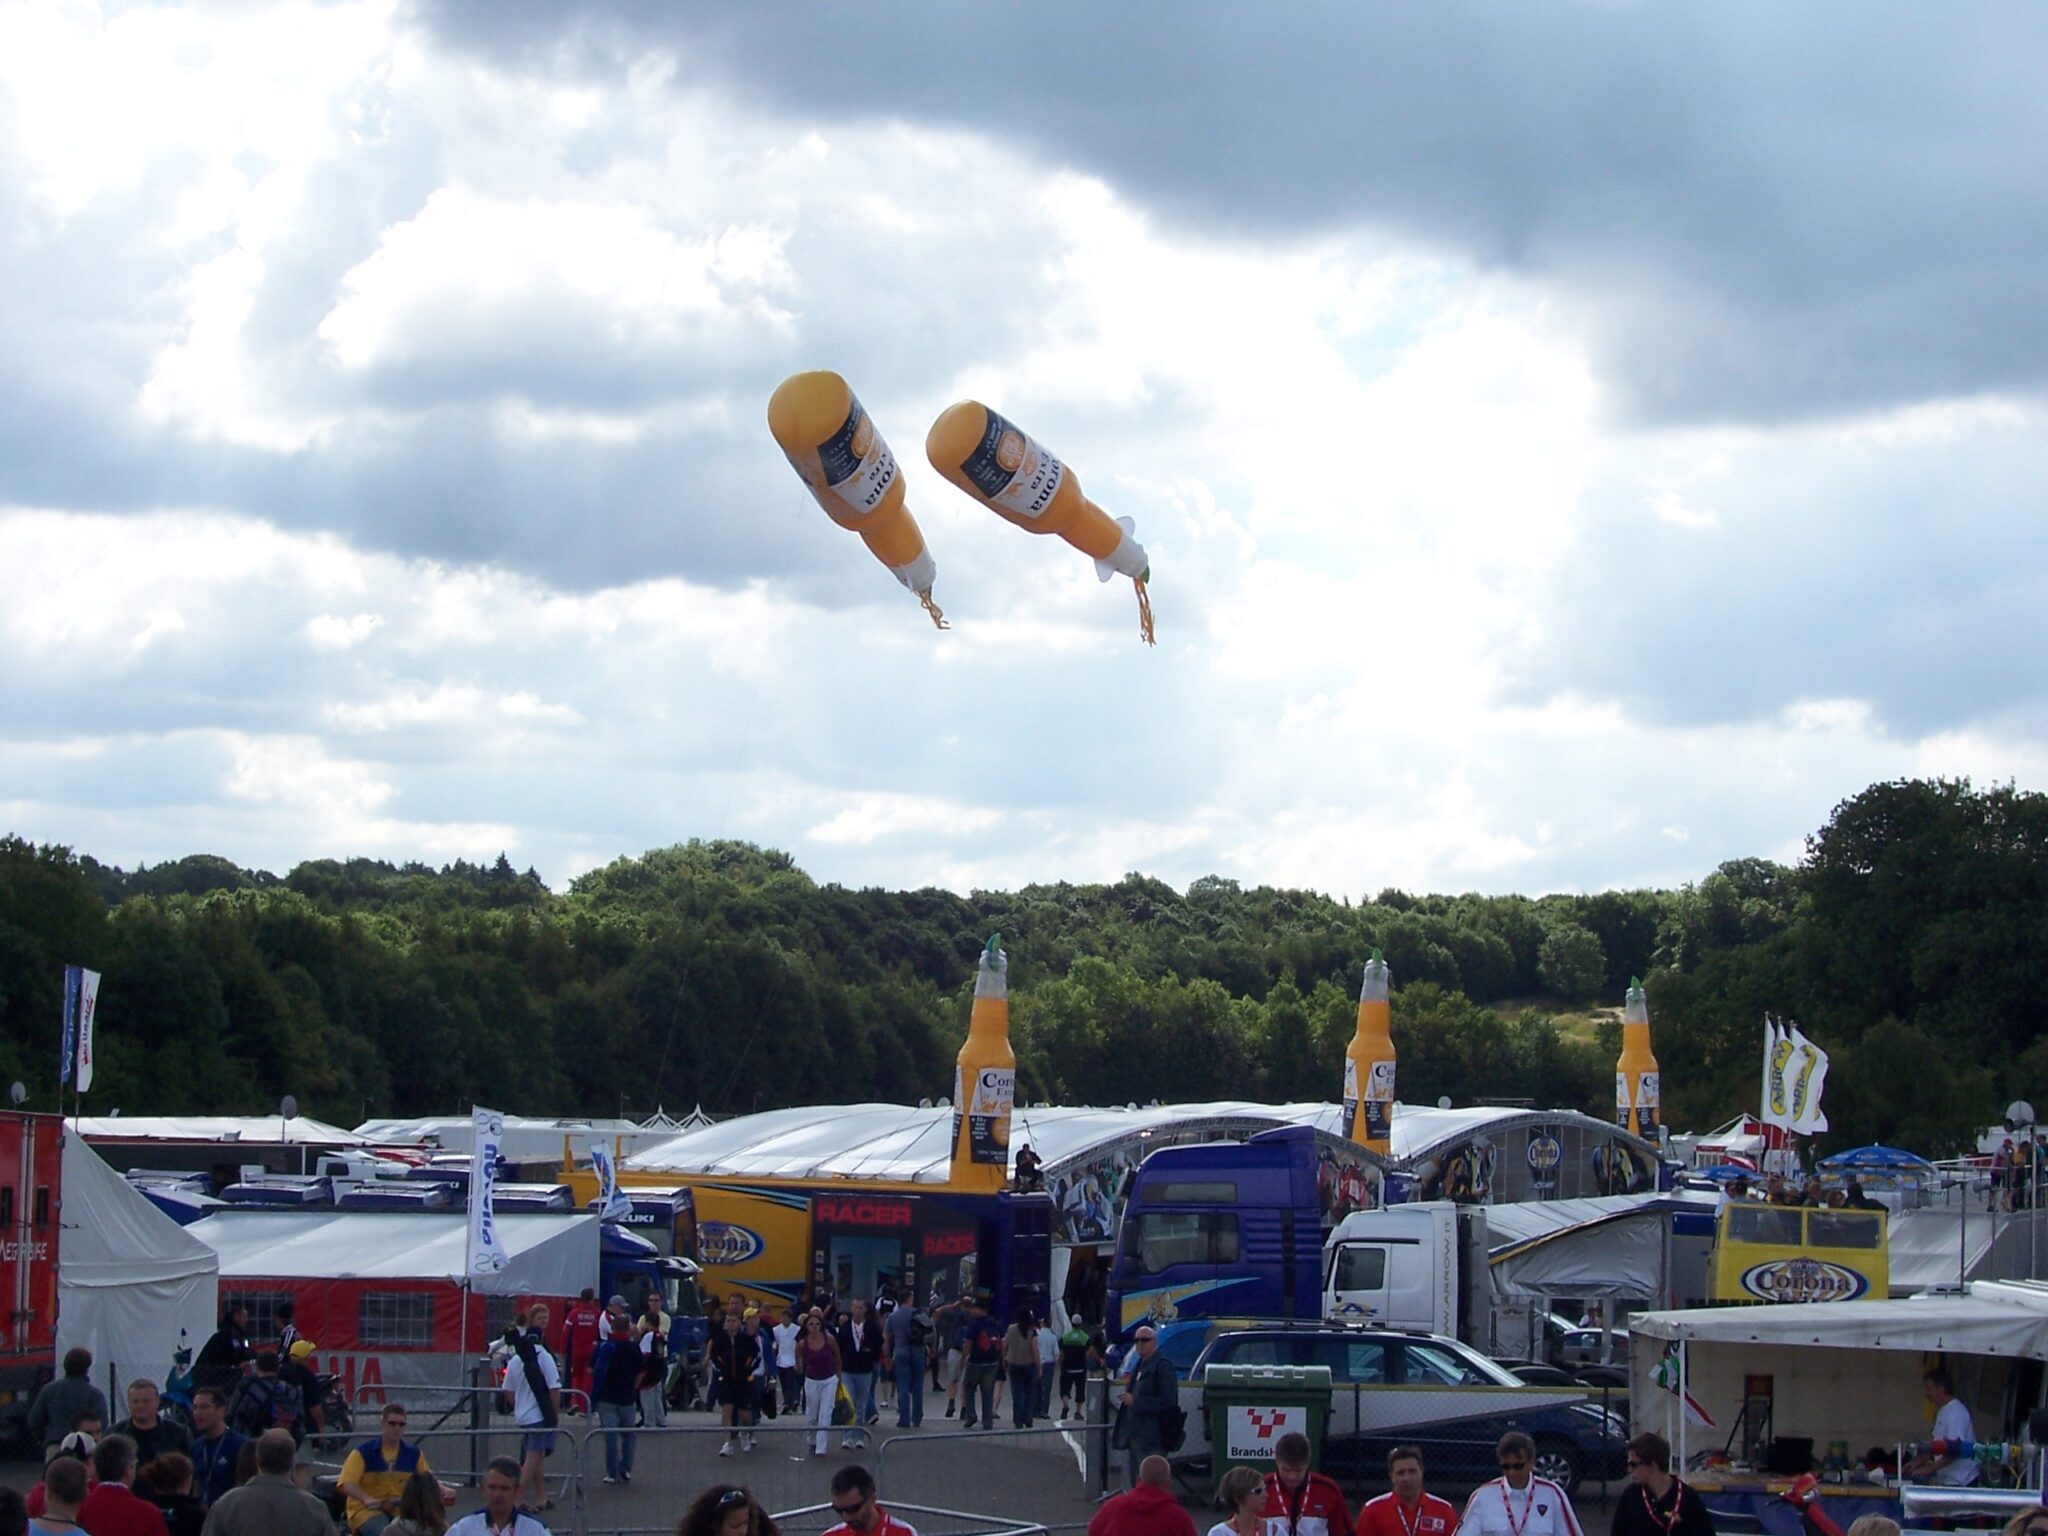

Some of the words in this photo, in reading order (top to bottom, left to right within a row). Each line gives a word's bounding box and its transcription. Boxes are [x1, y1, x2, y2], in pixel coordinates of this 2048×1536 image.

[817, 1202, 911, 1226] RACER
[923, 1233, 975, 1257] RACER
[1754, 1269, 1852, 1291] Corona
